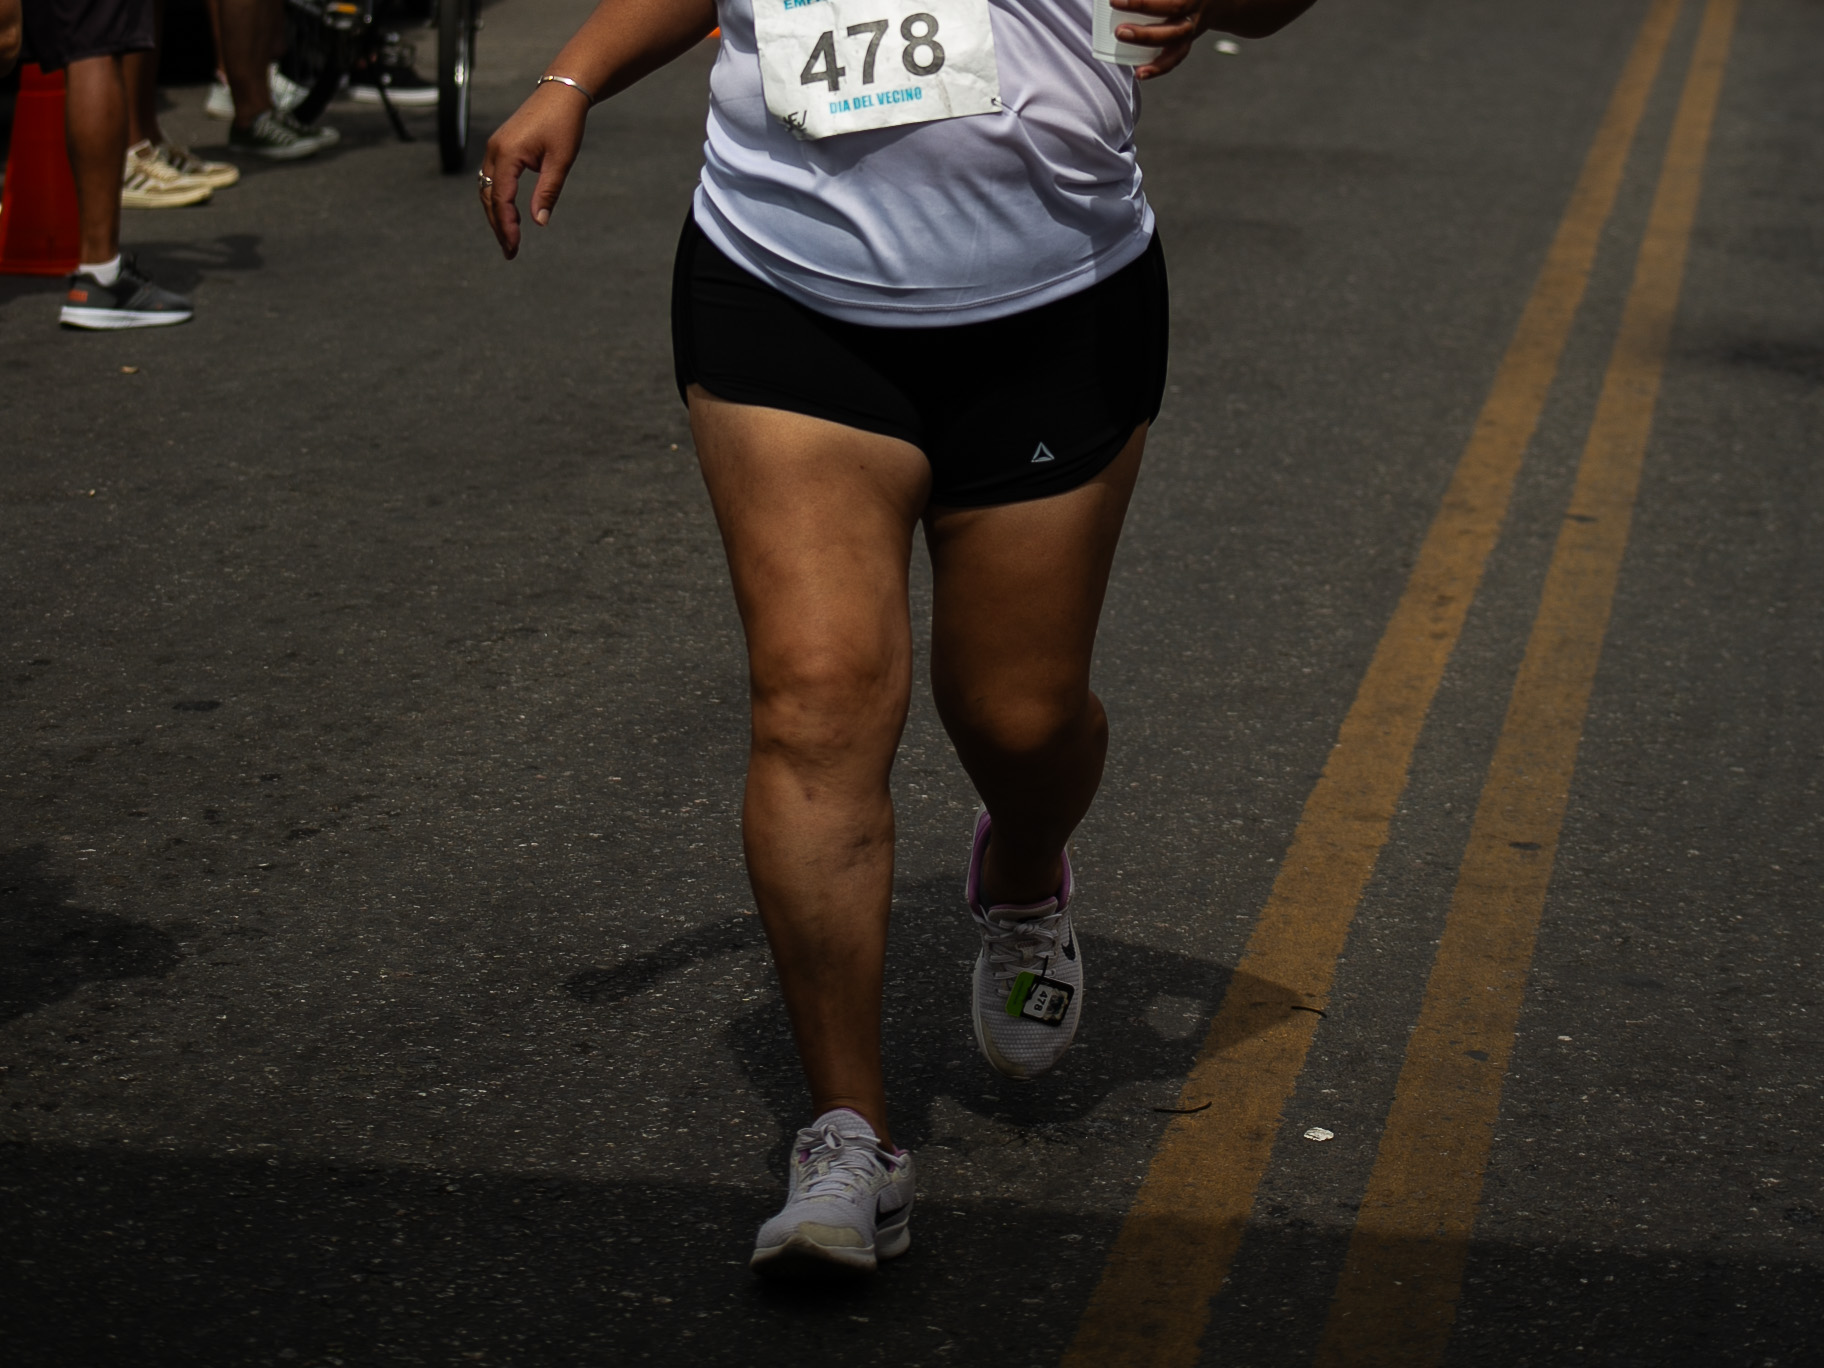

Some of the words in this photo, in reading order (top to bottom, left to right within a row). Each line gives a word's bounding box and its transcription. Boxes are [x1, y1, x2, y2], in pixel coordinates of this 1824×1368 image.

[800, 12, 945, 92] 478
[829, 99, 851, 114] DIA
[853, 95, 874, 110] DEL
[876, 86, 923, 106] VECINO
[1033, 990, 1048, 1011] 478
